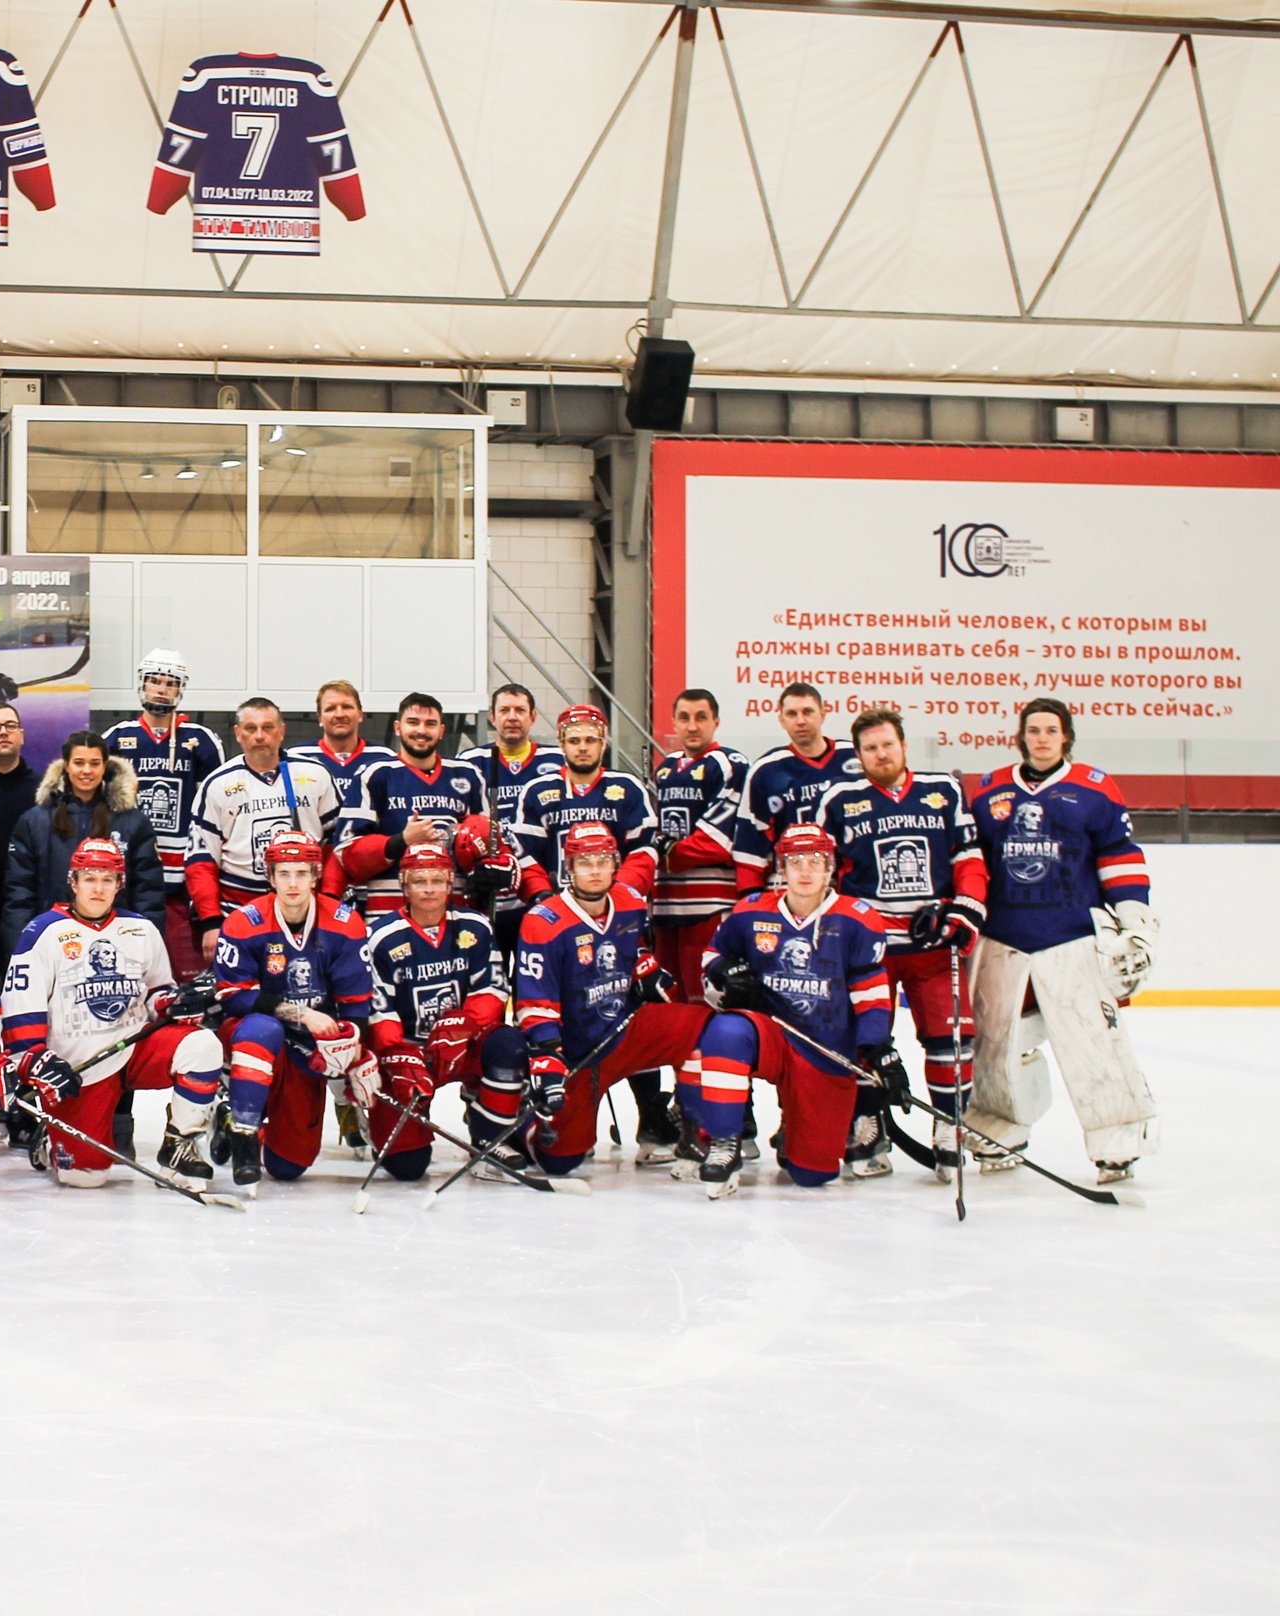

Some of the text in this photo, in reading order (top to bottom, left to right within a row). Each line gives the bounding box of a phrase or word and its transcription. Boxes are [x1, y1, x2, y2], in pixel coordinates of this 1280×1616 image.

[217, 85, 298, 107] СТРОМОВ
[168, 134, 192, 164] 7
[232, 111, 280, 180] 7
[321, 140, 342, 172] 7
[201, 187, 313, 202] 07.04.1977-10.03.2022
[200, 218, 313, 239] ТГУ ТАМБОВ
[12, 569, 70, 588] апреля
[17, 593, 71, 611] 2022 г.
[773, 608, 1207, 635] «Единственный человек, с которым вы
[736, 640, 830, 658] должны
[836, 641, 965, 660] сравнивать
[971, 639, 1020, 657] себя
[1042, 643, 1076, 658] это
[1083, 644, 1111, 659] вы
[1118, 645, 1128, 659] в
[1134, 645, 1241, 663] прошлом.
[737, 666, 1242, 691] И единственный человек, лучше которого вы
[847, 695, 901, 714] быть
[924, 700, 958, 714] это
[966, 700, 1007, 718] тот,
[1091, 702, 1136, 716] есть
[1143, 698, 1233, 718] сейчас.»
[959, 731, 1019, 750] Фрейд
[388, 797, 407, 810] ХК
[853, 820, 871, 838] ХК
[877, 814, 945, 834] ДЕРЖАВА
[58, 931, 82, 943] БЭСК
[76, 983, 139, 1000] ДЕРЖАВА
